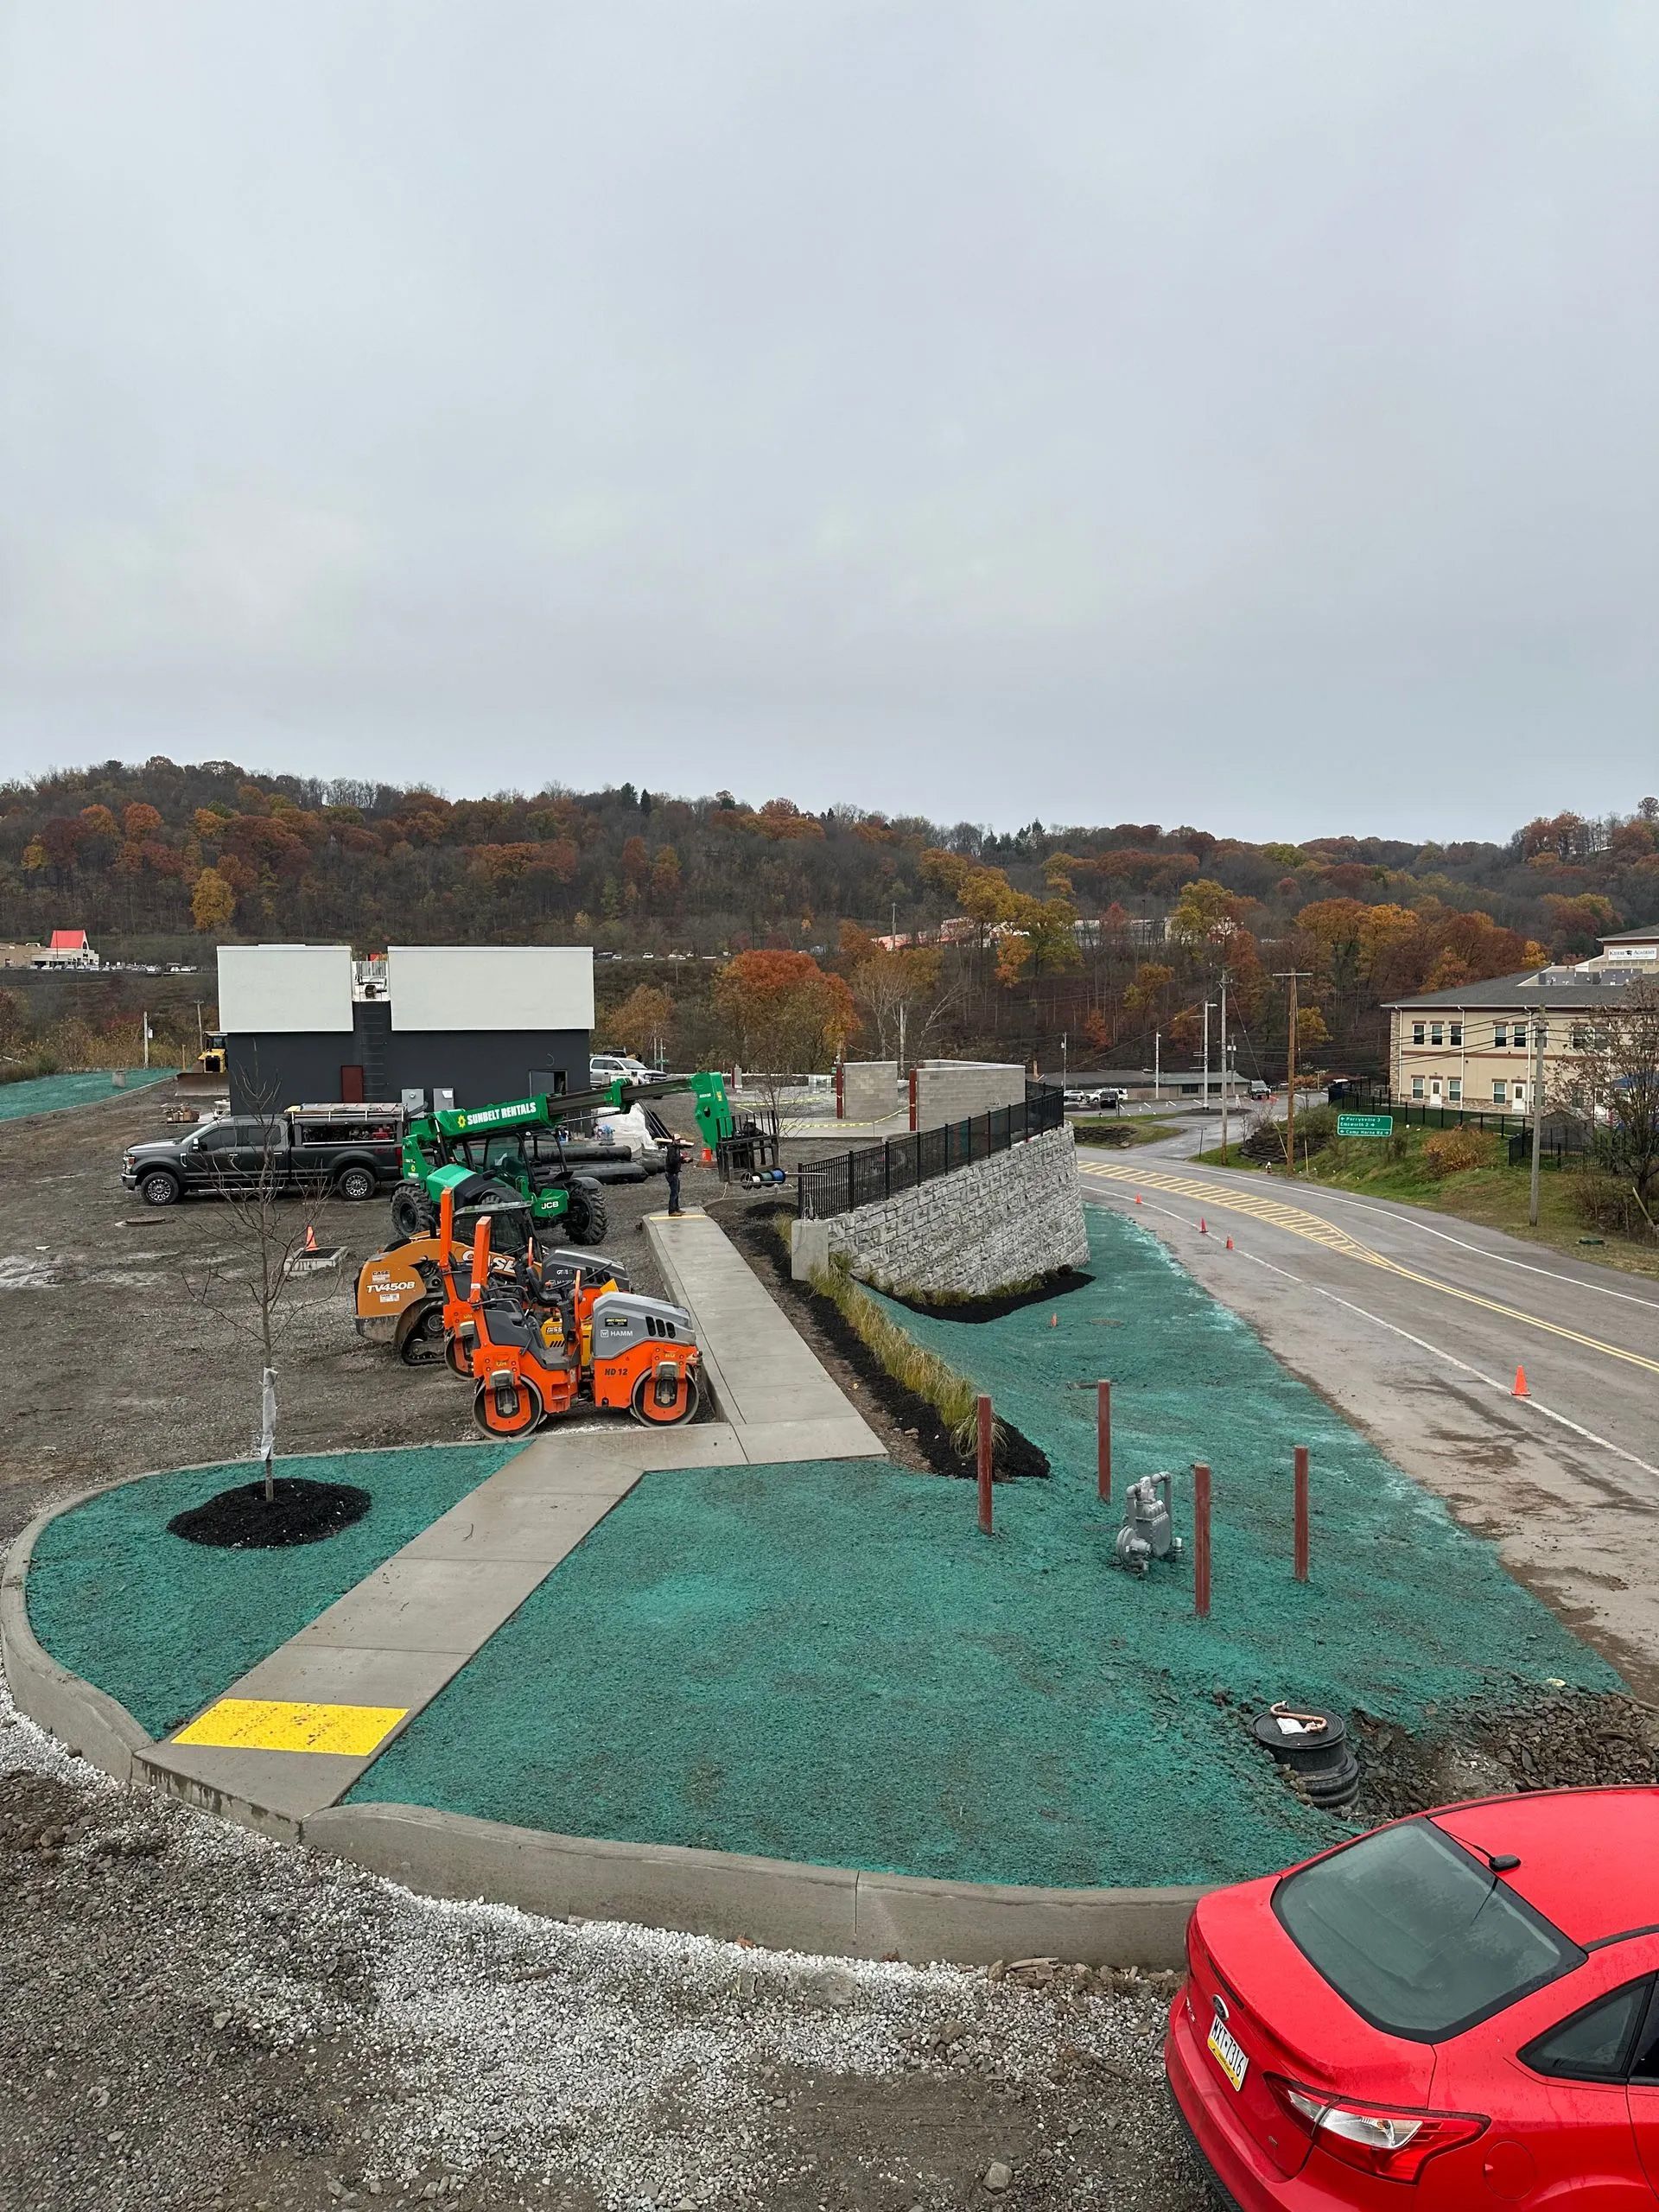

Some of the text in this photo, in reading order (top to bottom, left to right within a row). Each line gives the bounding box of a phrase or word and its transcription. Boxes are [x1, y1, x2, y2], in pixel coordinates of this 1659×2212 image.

[467, 1102, 537, 1125] SUNBELT RENTALS
[541, 1201, 559, 1210] JCB
[366, 1281, 415, 1293] TV450B
